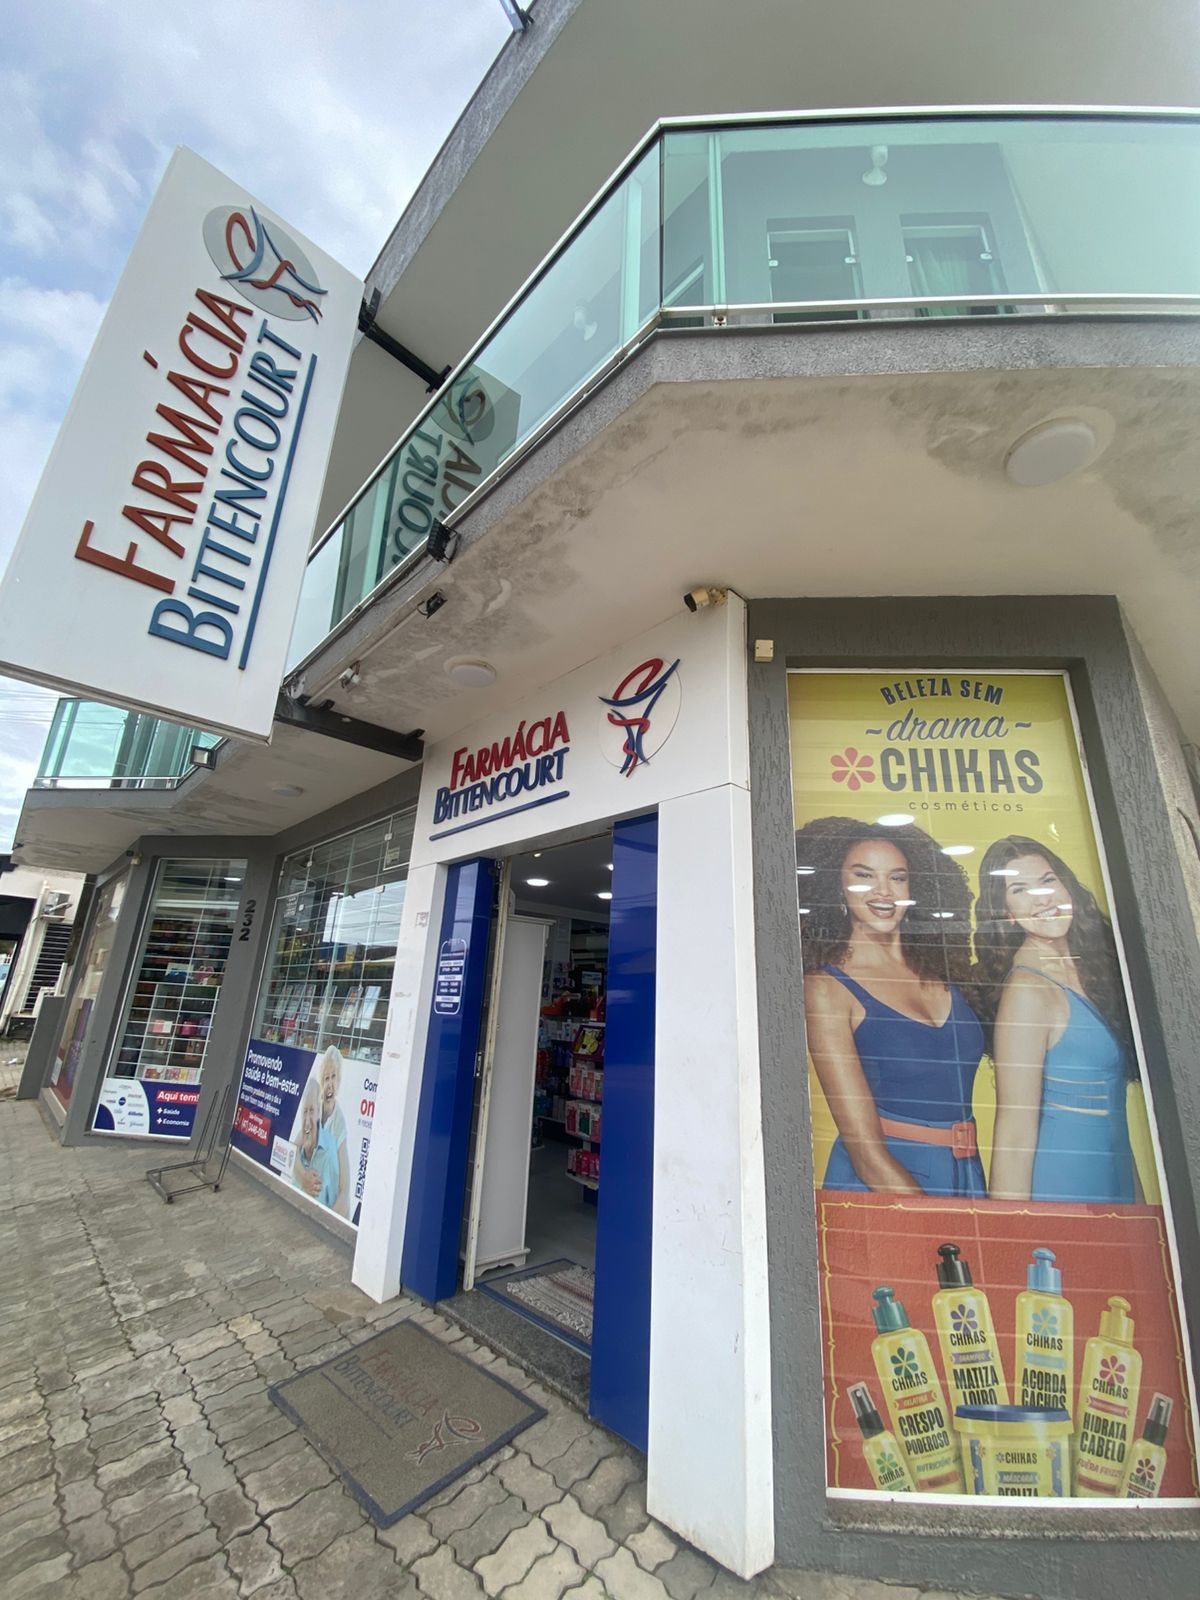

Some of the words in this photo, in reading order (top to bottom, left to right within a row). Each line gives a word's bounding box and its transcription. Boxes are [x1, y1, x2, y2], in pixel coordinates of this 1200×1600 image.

[74, 287, 254, 594] FARMÁCIA
[147, 318, 303, 660] BITTENCOURT
[880, 678, 952, 706] BELEZA
[960, 679, 1004, 706] SEM
[450, 710, 570, 790] FARMÁCIA
[880, 747, 1043, 794] CHIKAS
[433, 746, 570, 824] BITTENCOURT
[909, 799, 1024, 812] cosméticos
[239, 899, 256, 941] 232
[247, 1049, 283, 1072] Promovendo
[245, 1066, 261, 1082] saúde
[261, 1072, 266, 1083] e
[265, 1070, 300, 1096] bem-estar.
[157, 1091, 178, 1102] Aqui
[180, 1092, 200, 1103] tem!
[163, 1119, 189, 1127] Economia
[950, 1330, 986, 1346] CHIKAS
[1026, 1333, 1063, 1351] CHIKAS
[891, 1371, 928, 1392] CHIKAS
[953, 1365, 999, 1390] MATIZA
[1022, 1368, 1067, 1394] ACORDA
[1092, 1378, 1128, 1400] CHIKAS
[898, 1407, 944, 1437] CRESPO
[1083, 1412, 1127, 1441] HIDRATA
[905, 1431, 950, 1455] PODEROSO
[1080, 1431, 1126, 1464] CABELO
[1005, 1452, 1037, 1464] CHIKAS
[878, 1467, 905, 1486] CHIKAS
